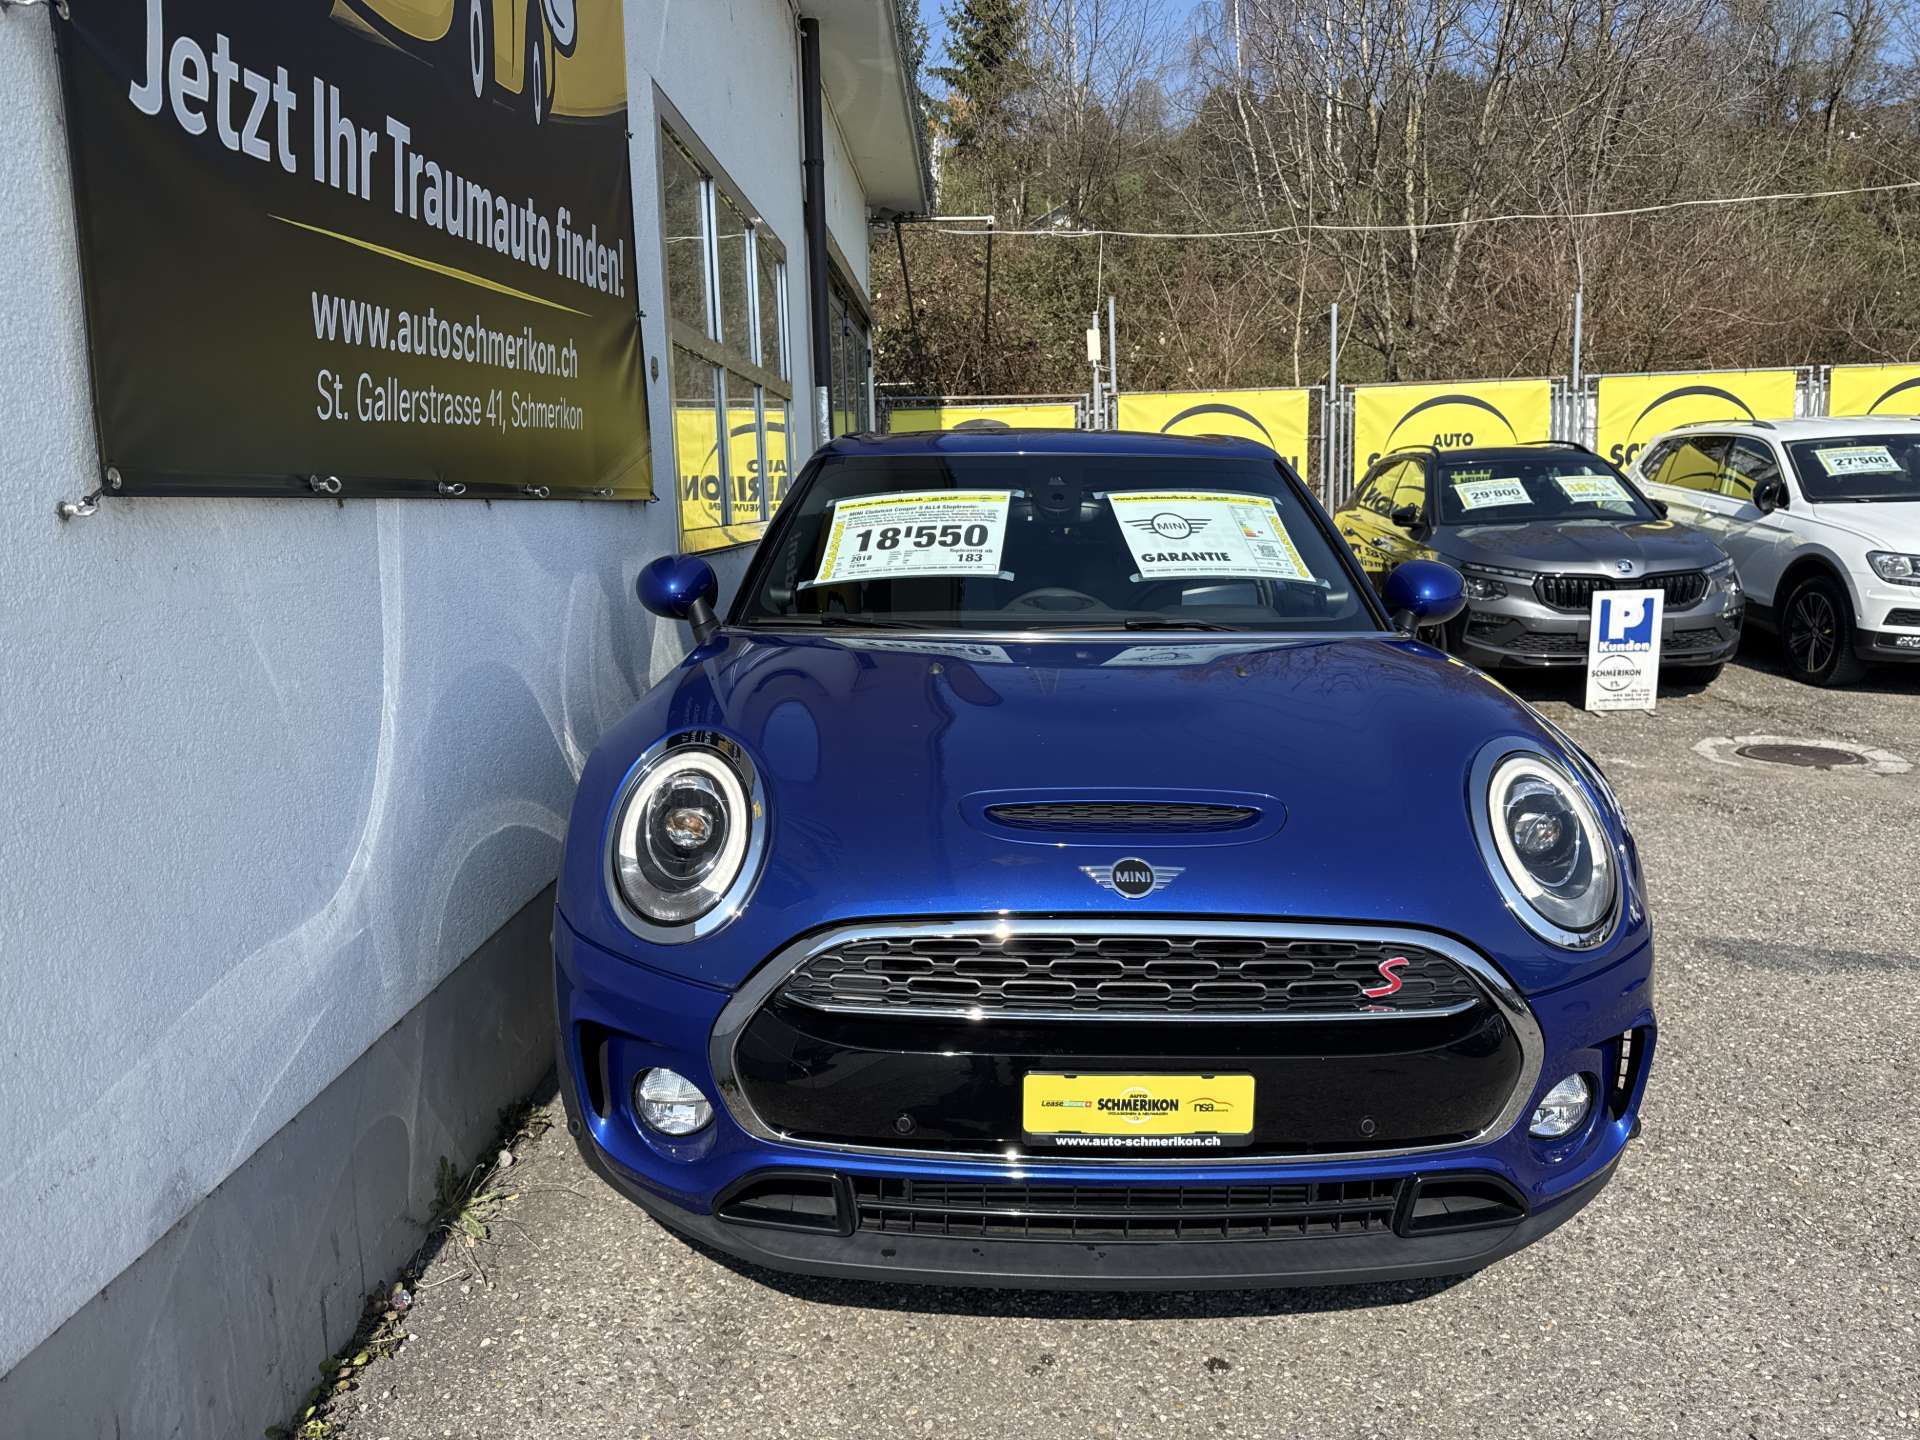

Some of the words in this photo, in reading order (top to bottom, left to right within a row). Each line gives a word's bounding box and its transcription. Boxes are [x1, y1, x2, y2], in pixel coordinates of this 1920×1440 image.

[128, 0, 297, 174] Jetzt
[312, 76, 378, 202] Ihr
[386, 114, 551, 271] Traumauto
[556, 206, 626, 299] finden!
[311, 290, 579, 380] www.autoschmerikon.ch
[316, 369, 349, 422] St.
[356, 371, 482, 428] Gallerstrasse
[485, 395, 507, 434] 41,
[510, 394, 584, 432] Schmerikon
[1433, 432, 1474, 448] AUTO
[1834, 456, 1889, 466] 27'500
[1471, 488, 1521, 500] 29'800
[1156, 521, 1187, 531] MINI
[856, 524, 989, 552] 18'550
[850, 554, 872, 563] 2018
[957, 553, 983, 562] 183
[1141, 551, 1231, 563] GARANTIE
[1608, 598, 1645, 640] P
[1599, 640, 1650, 652] Kunden
[1591, 668, 1641, 678] SCHMERIKON
[1115, 871, 1151, 883] MINI
[1362, 956, 1410, 998] S
[1041, 1100, 1064, 1108] Lease
[1097, 1098, 1179, 1112] SCHMERIKON
[1194, 1103, 1214, 1112] nsa
[1055, 1136, 1221, 1147] www.auto-schmerikon.ch
